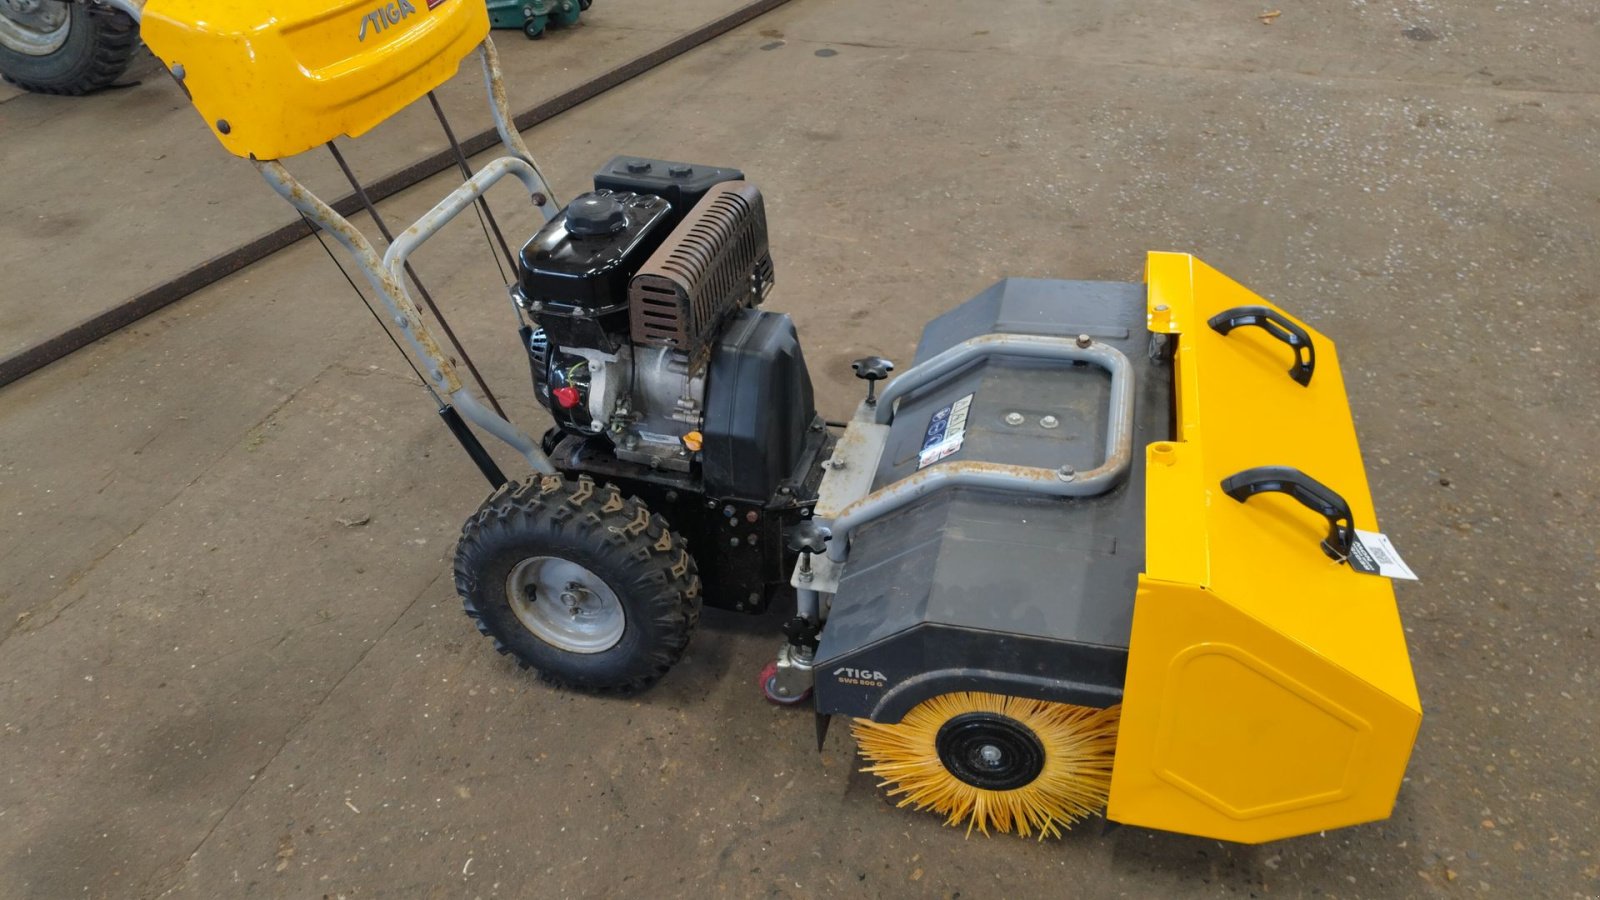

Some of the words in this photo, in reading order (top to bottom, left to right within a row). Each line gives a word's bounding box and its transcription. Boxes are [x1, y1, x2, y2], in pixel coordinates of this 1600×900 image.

[358, 0, 416, 42] STIGA
[833, 667, 888, 681] STIGA
[838, 677, 859, 685] SWS
